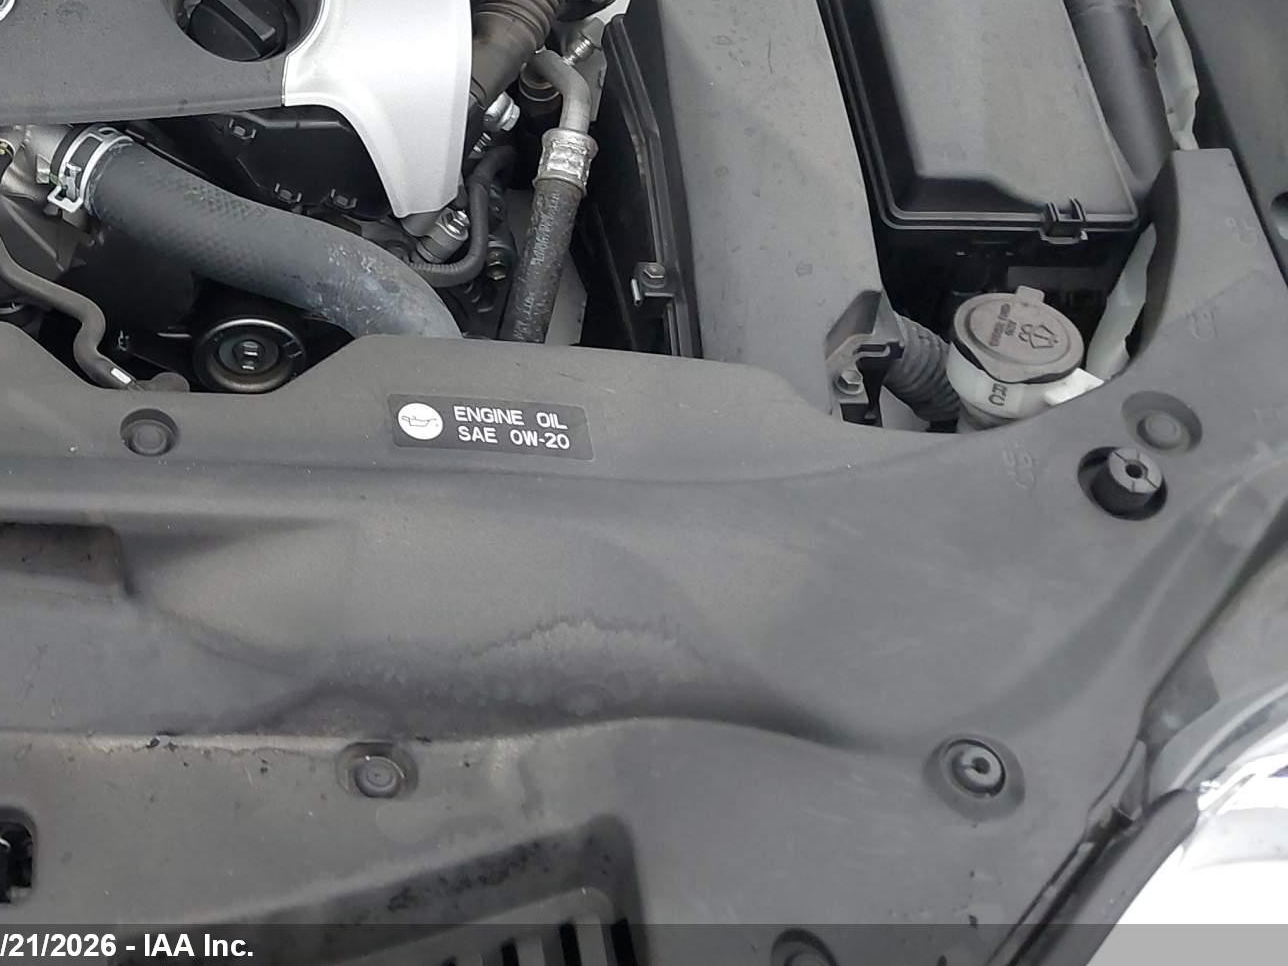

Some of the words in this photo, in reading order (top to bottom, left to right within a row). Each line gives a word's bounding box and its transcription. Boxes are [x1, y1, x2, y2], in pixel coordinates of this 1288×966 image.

[453, 405, 525, 426] ENGINE
[535, 411, 569, 430] OIL
[457, 425, 498, 444] SAE
[509, 430, 571, 450] 0W-20
